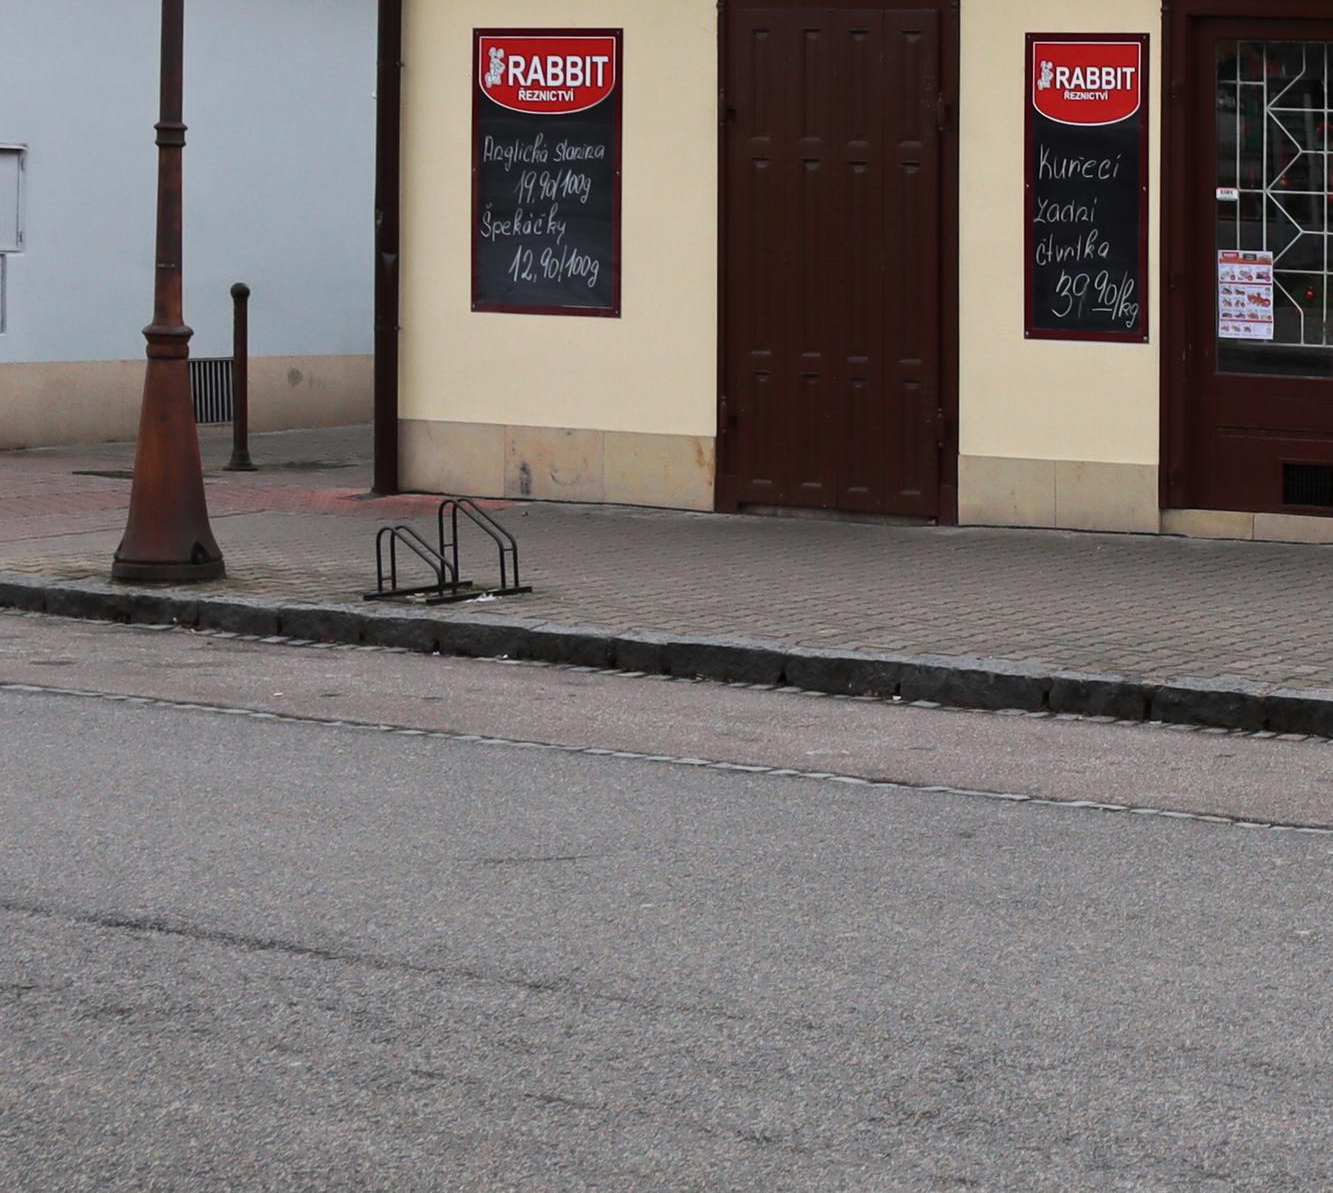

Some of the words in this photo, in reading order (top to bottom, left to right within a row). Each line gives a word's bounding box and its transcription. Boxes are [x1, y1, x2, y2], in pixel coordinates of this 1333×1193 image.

[507, 54, 610, 88] RABBIT
[1055, 66, 1136, 91] RABBIT
[518, 87, 574, 102] ŘEZNICTVÍ
[1063, 90, 1109, 101] ŘEZNICTVÍ
[483, 132, 549, 173] Anglická
[480, 202, 567, 246] Špekáčky
